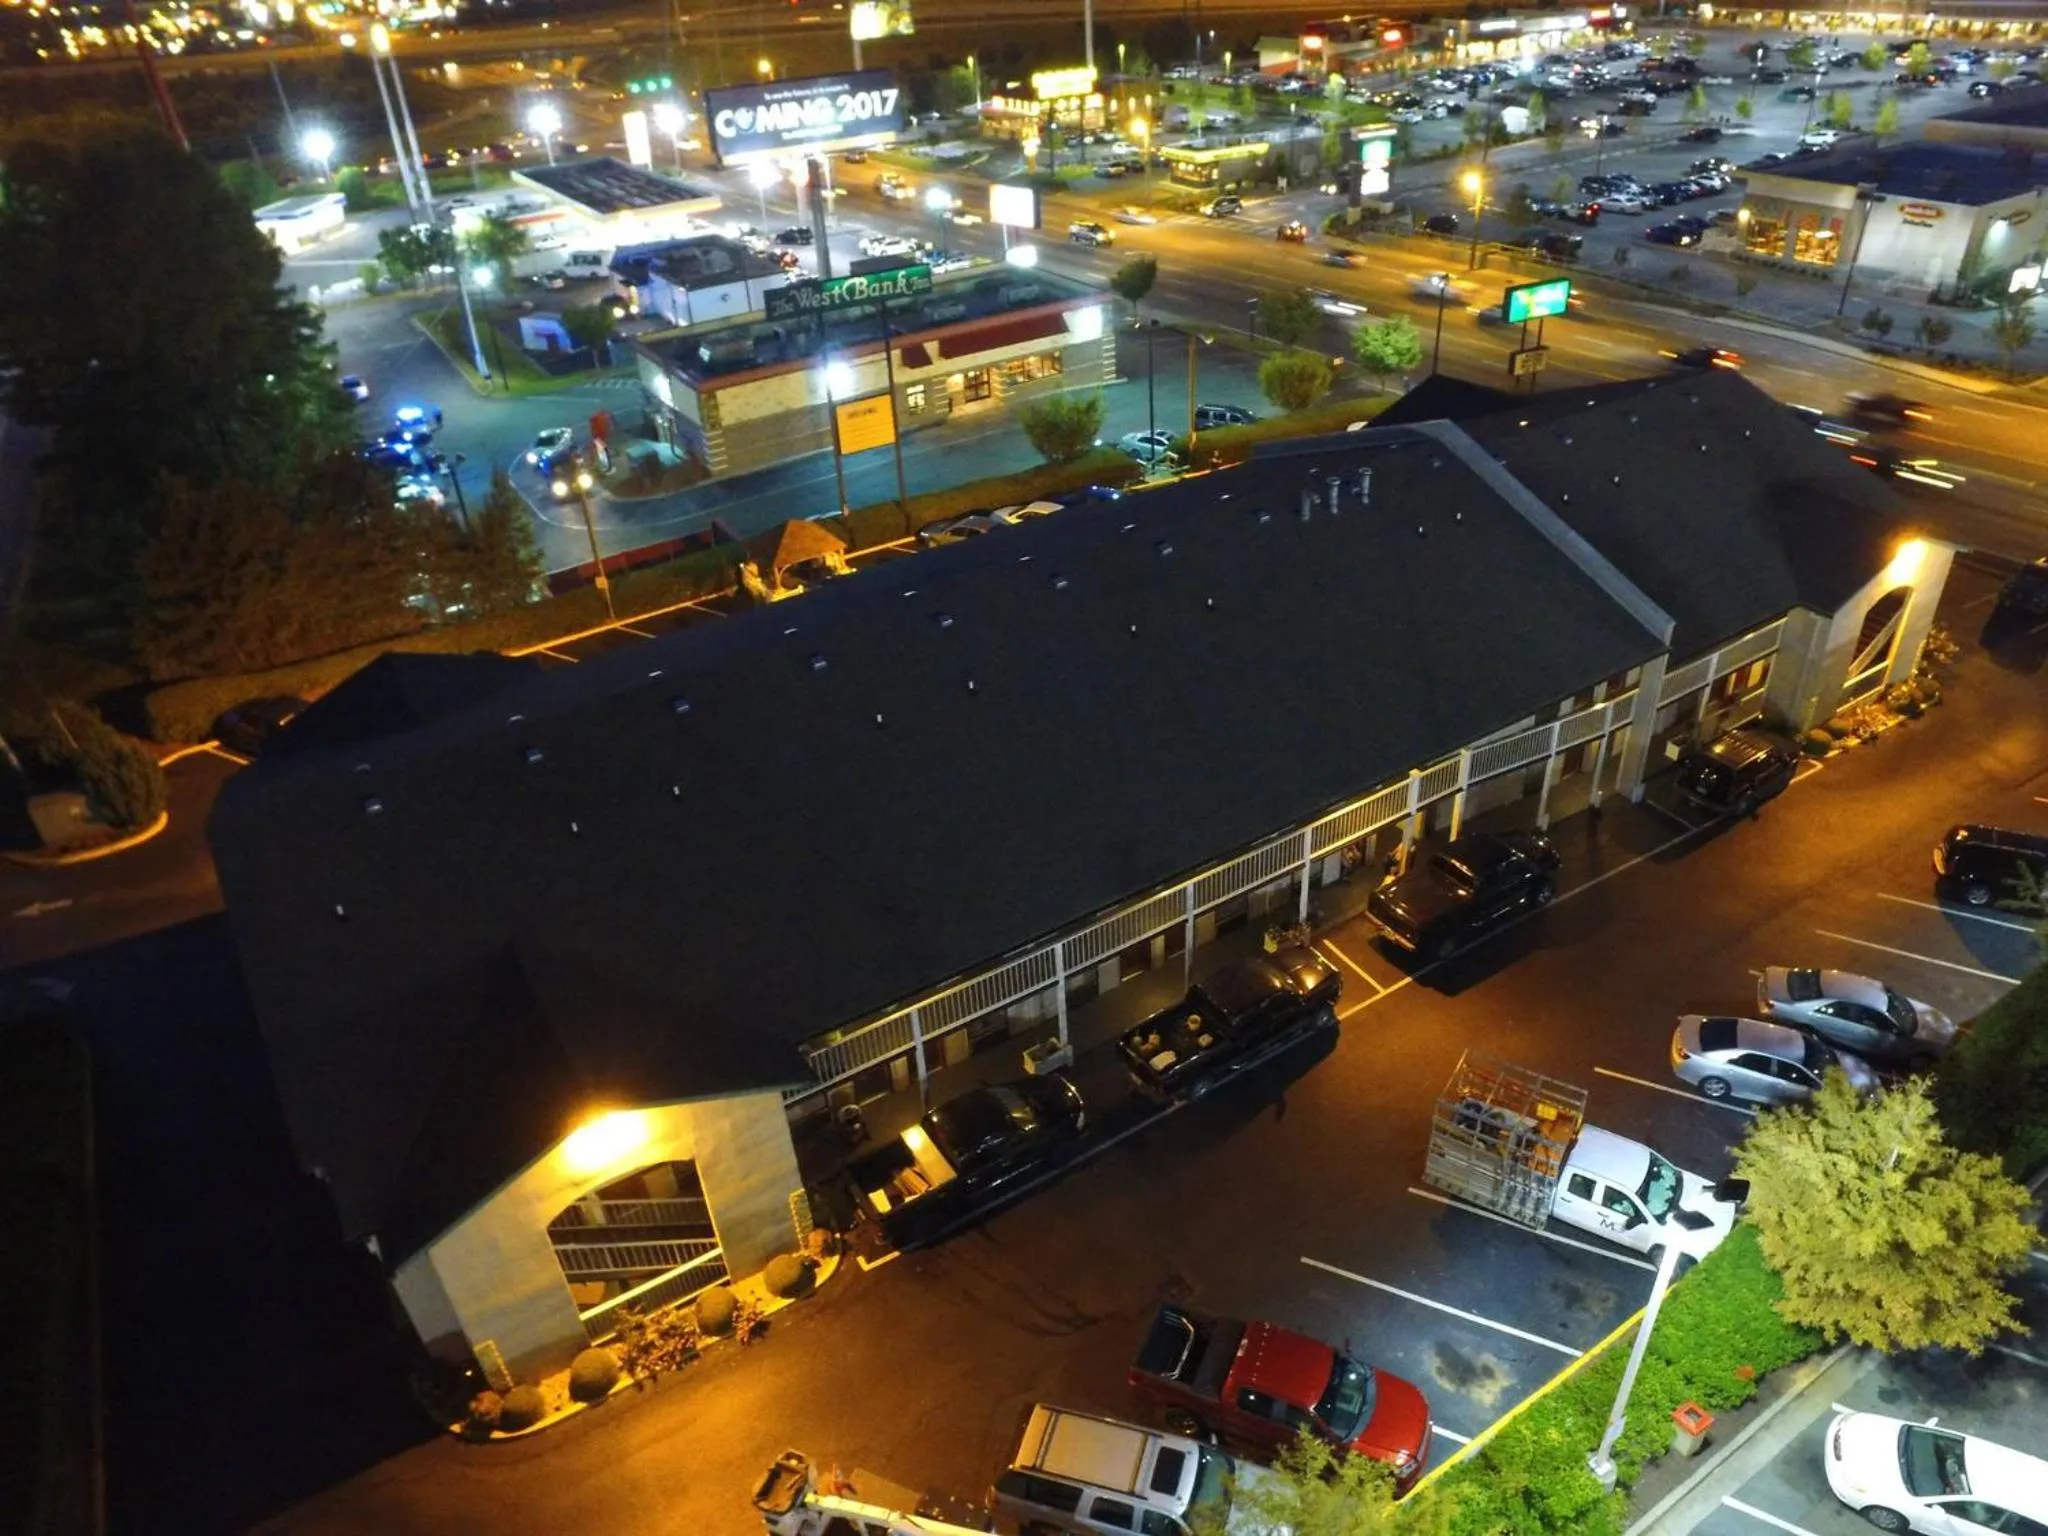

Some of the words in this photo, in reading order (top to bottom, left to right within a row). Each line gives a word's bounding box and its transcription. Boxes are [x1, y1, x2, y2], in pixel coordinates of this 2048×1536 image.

[714, 97, 836, 138] COMING
[836, 88, 900, 122] 2017
[789, 284, 841, 309] West
[842, 271, 913, 302] Bank
